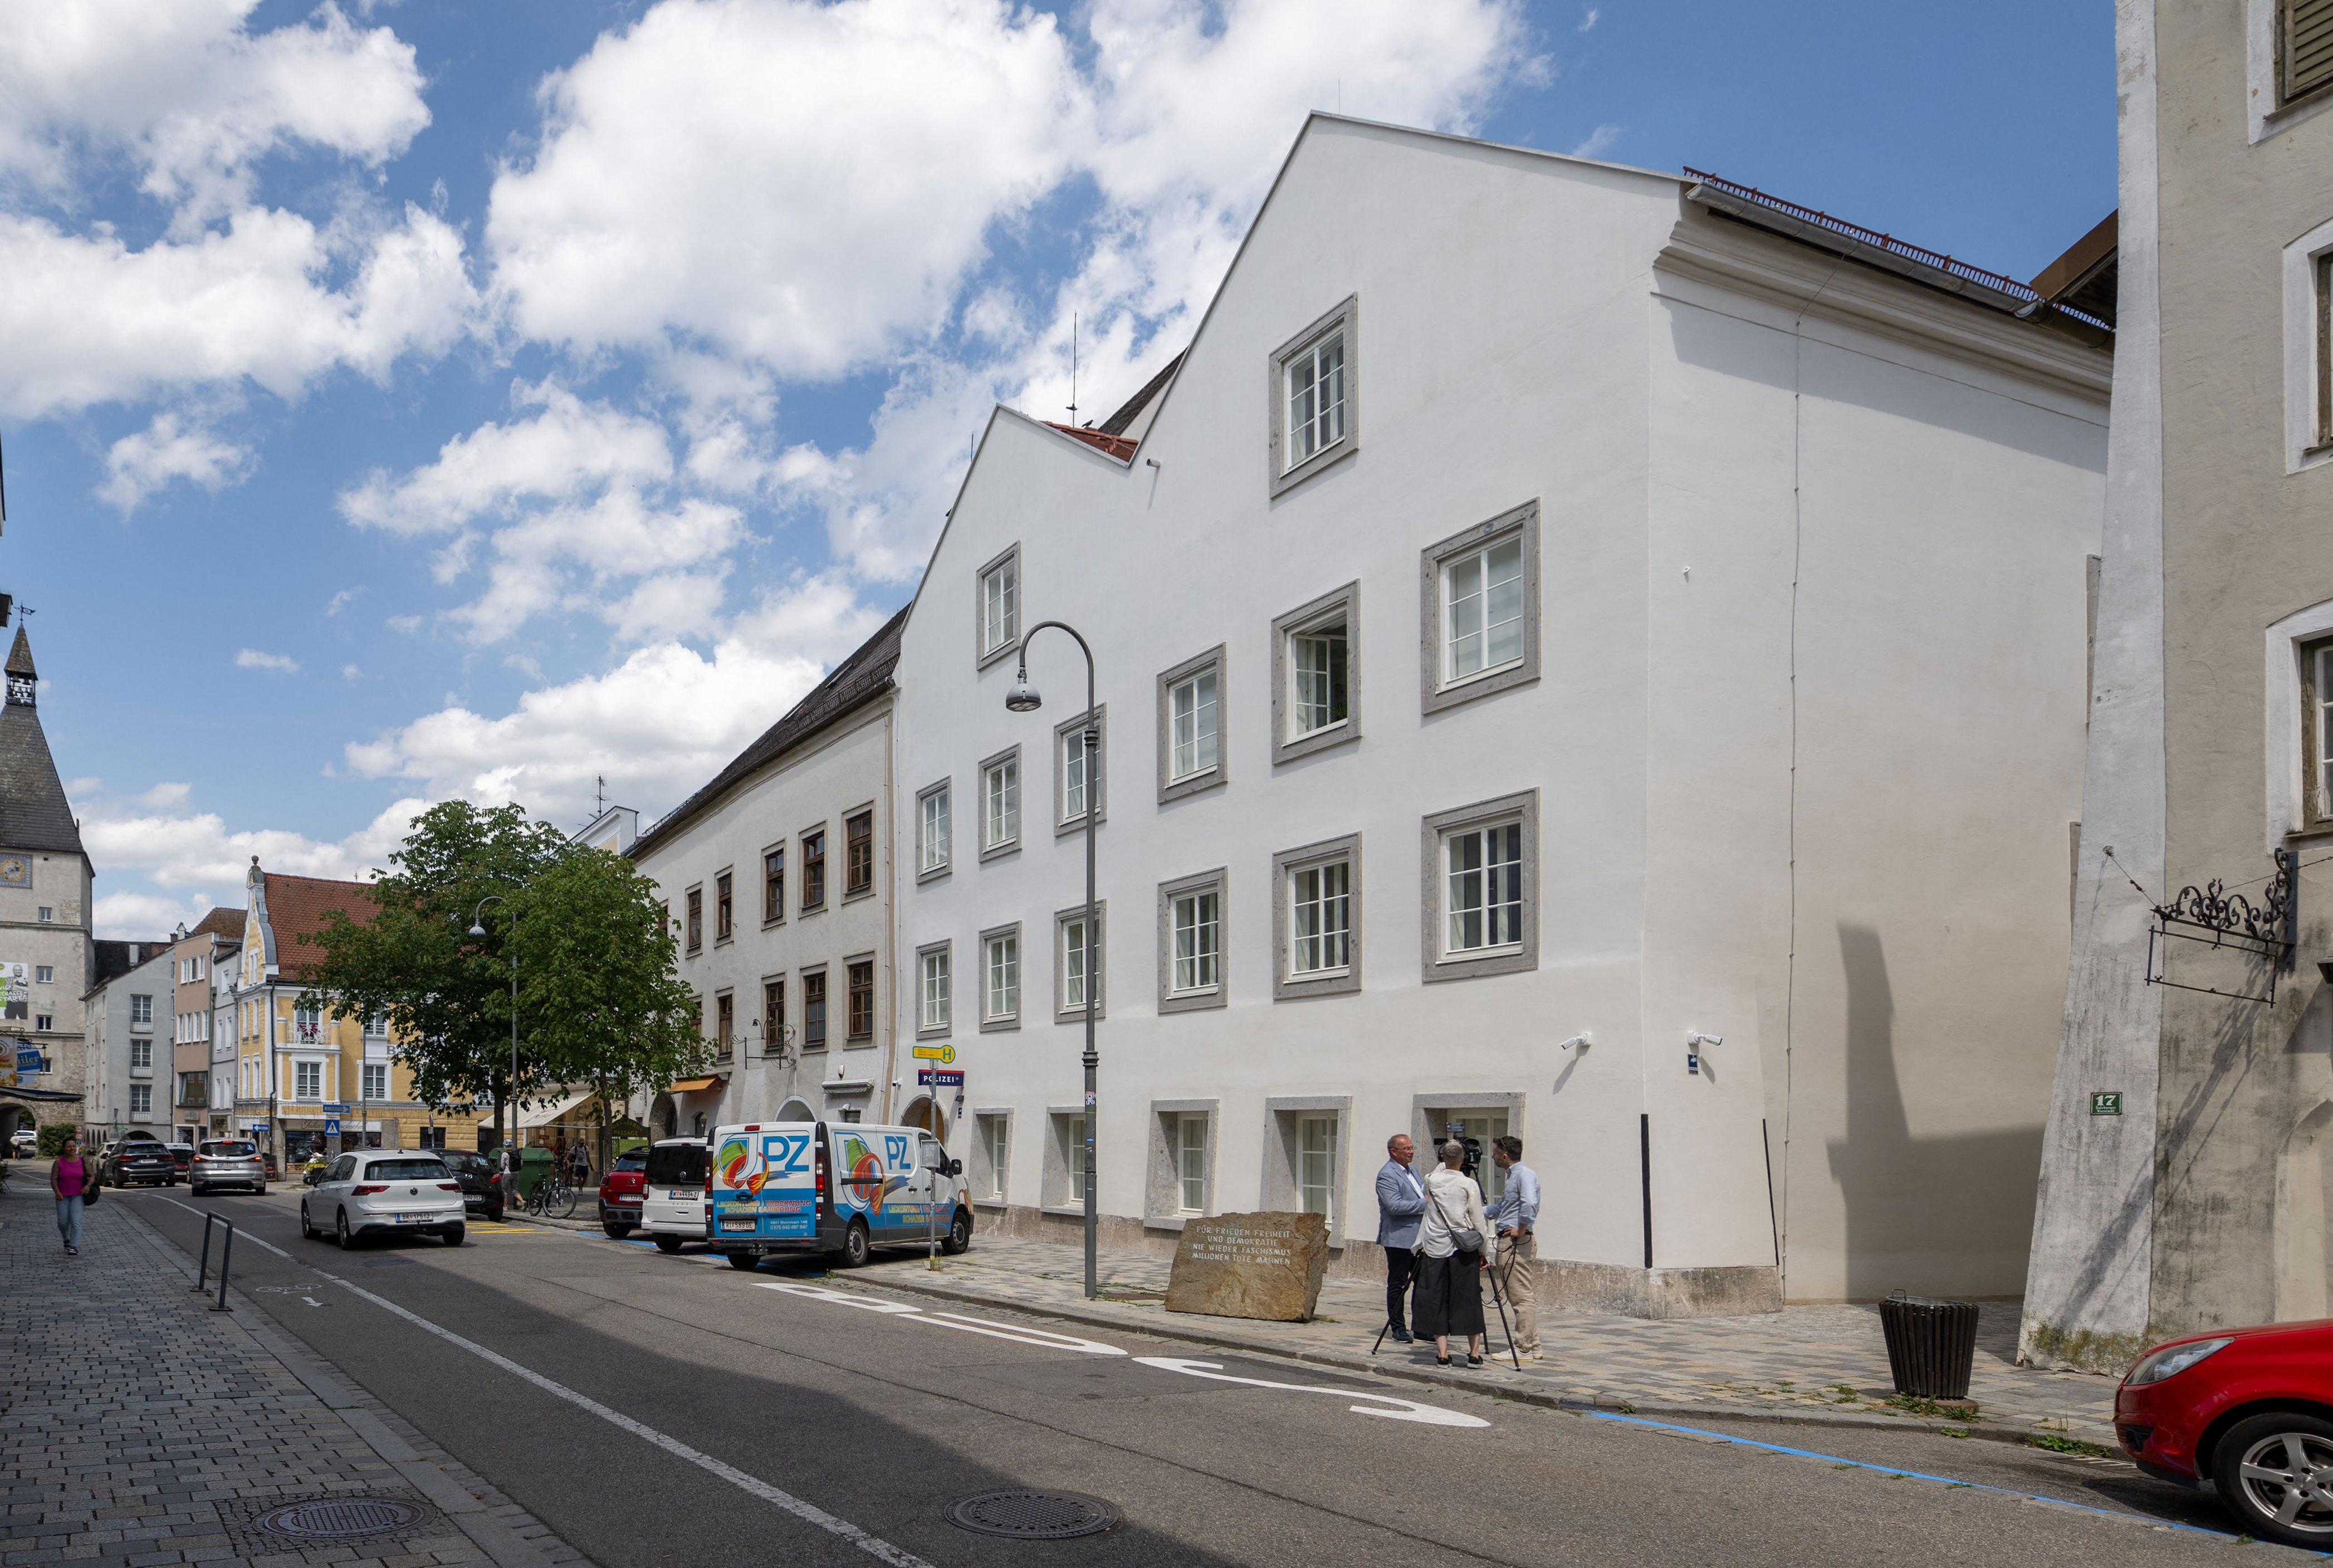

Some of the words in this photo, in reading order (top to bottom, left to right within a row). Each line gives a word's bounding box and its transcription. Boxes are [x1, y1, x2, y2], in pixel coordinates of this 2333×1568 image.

[943, 1048, 951, 1060] H
[2096, 1095, 2116, 1105] 17
[1197, 1225, 1211, 1233] FÜR
[1216, 1227, 1250, 1236] FRIEDEN
[1254, 1229, 1290, 1238] FREIHEIT
[1227, 1237, 1278, 1246] DEMOKRATIE
[1209, 1244, 1238, 1253] WIEDER
[1242, 1247, 1291, 1256] FASCHISMUS
[1192, 1252, 1230, 1261] MILLIONEN
